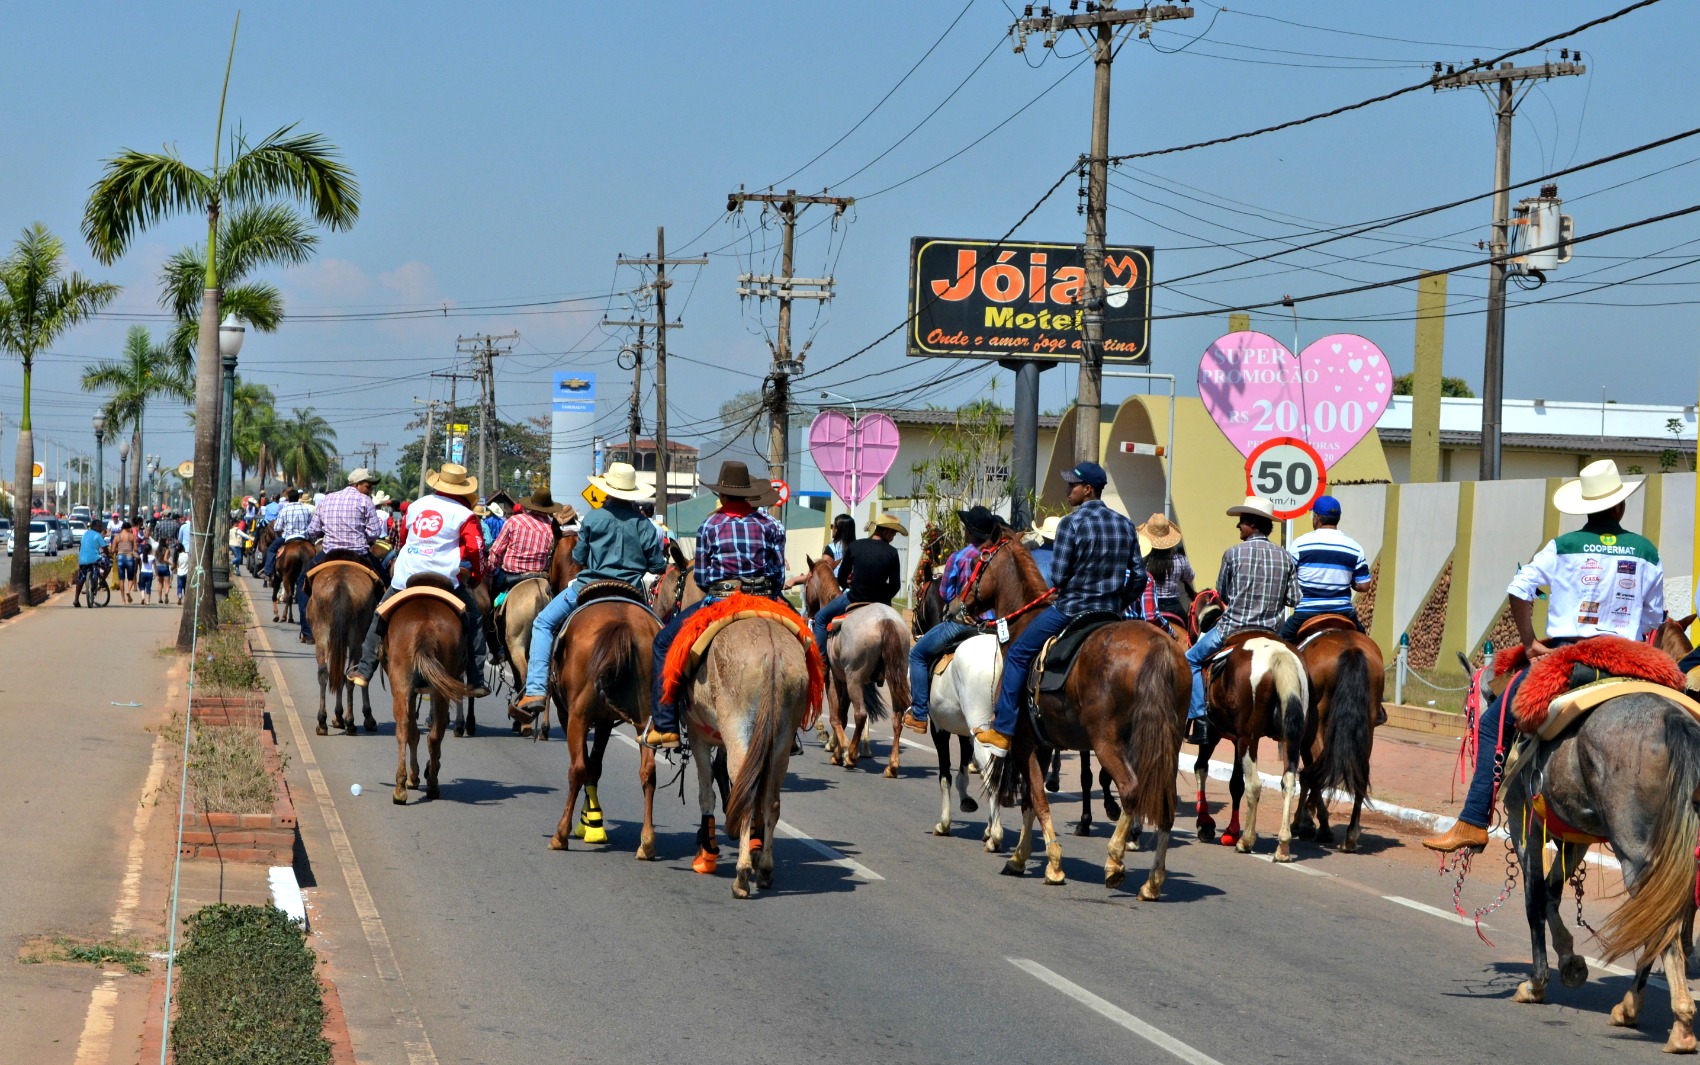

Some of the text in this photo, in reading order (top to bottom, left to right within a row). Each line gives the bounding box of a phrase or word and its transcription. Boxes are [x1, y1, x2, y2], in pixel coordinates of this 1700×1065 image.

[931, 249, 1085, 304] Jóia
[984, 306, 1084, 331] Motel
[927, 328, 969, 345] Onde
[989, 336, 1029, 347] amor
[1213, 348, 1286, 365] SUPER
[1202, 366, 1319, 386] PROMOÇÃO
[1252, 400, 1364, 440] 20,00
[1256, 461, 1312, 496] 50
[1583, 544, 1636, 555] COOPERMAT
